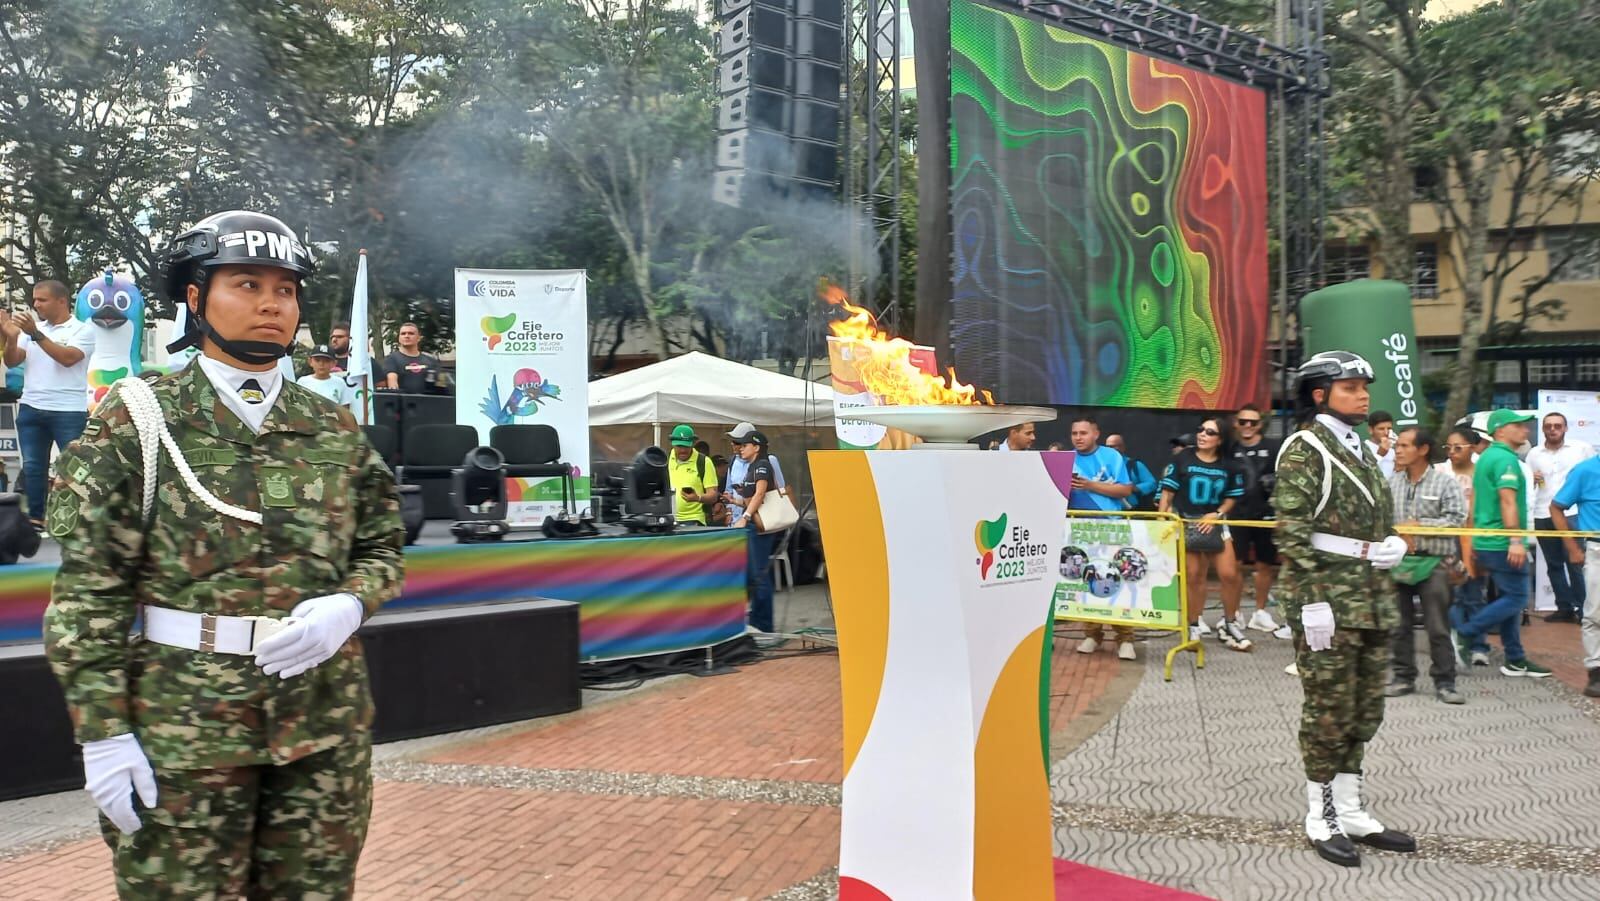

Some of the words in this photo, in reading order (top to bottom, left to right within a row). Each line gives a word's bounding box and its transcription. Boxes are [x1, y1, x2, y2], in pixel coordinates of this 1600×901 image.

[245, 230, 293, 261] PM
[489, 289, 516, 297] VIDA
[522, 321, 542, 332] Eje
[507, 331, 563, 340] Cafetero
[505, 342, 536, 351] 2023
[1381, 333, 1418, 426] lecafé
[1189, 475, 1225, 505] 01
[1012, 526, 1029, 544] Eje
[999, 543, 1047, 560] Cafetero
[996, 561, 1024, 579] 2023
[1140, 609, 1163, 618] VAS
